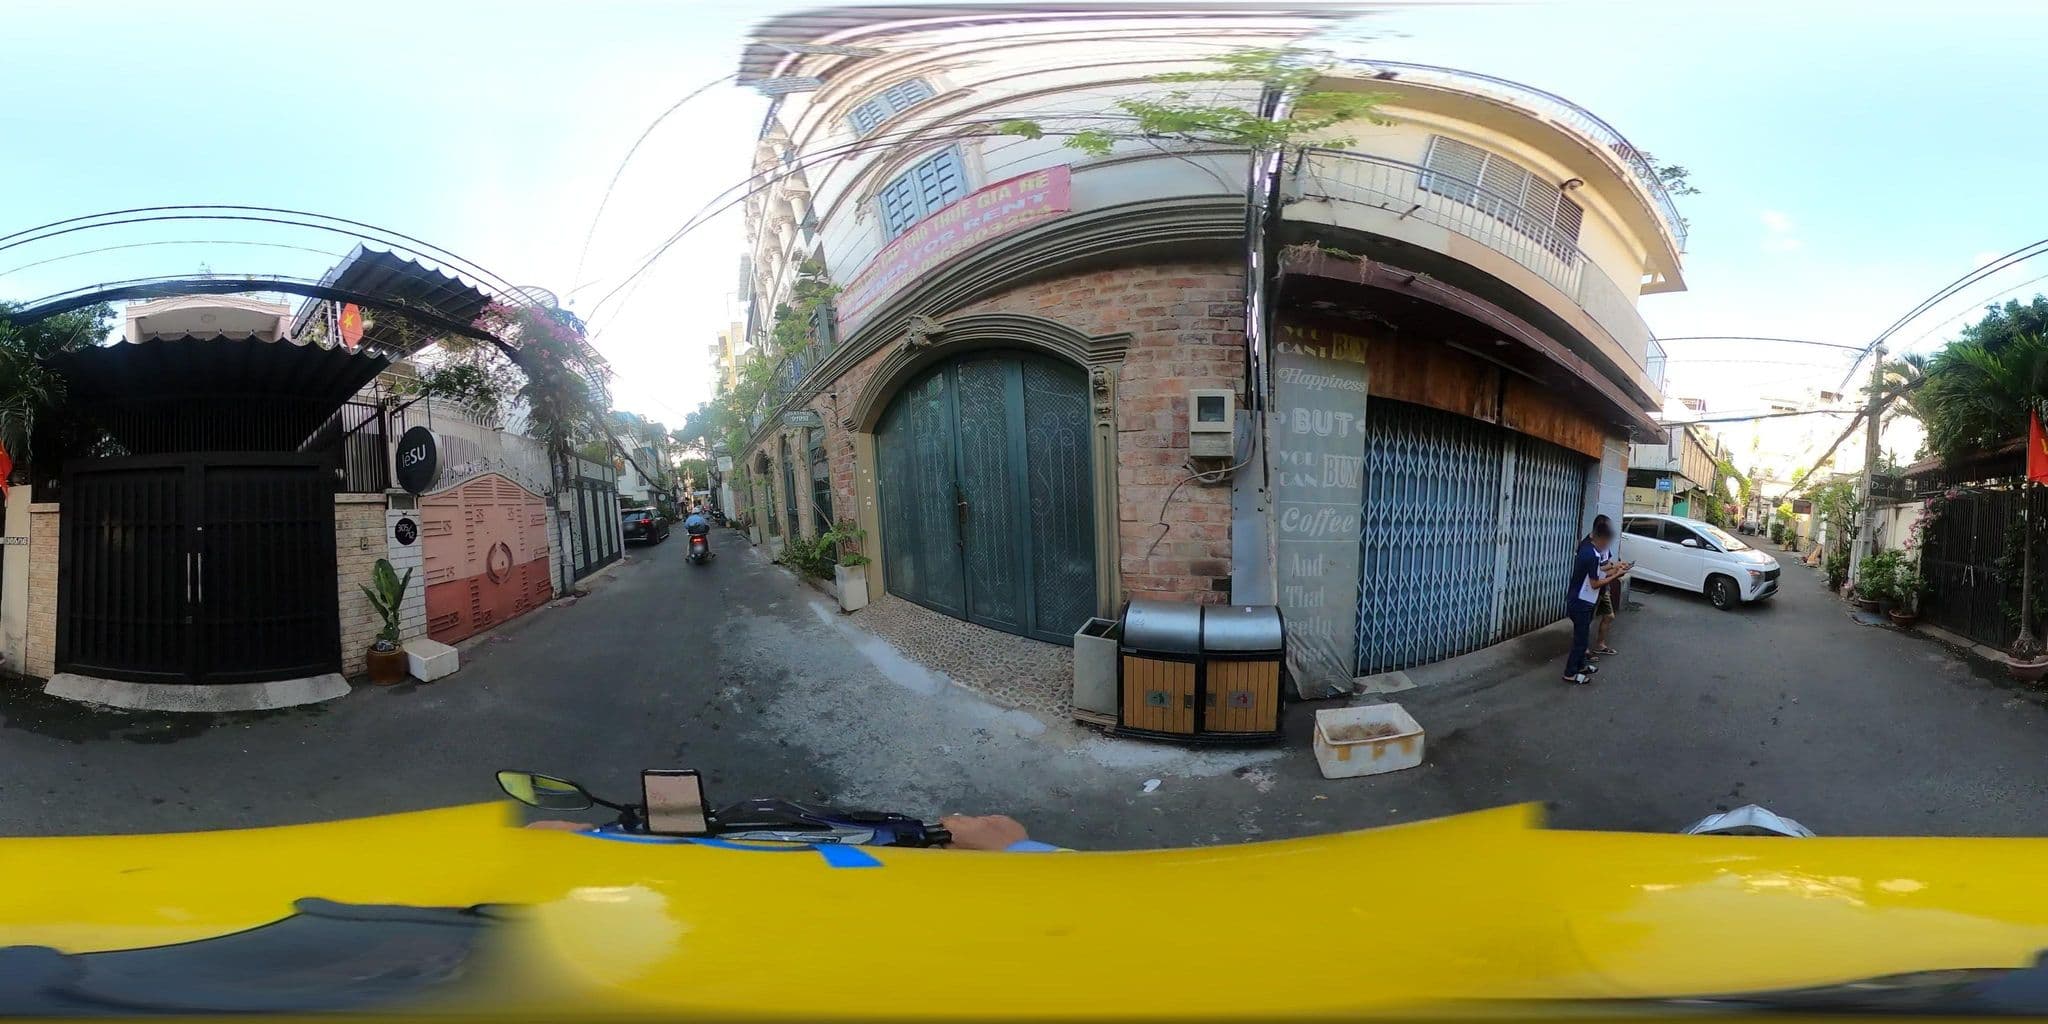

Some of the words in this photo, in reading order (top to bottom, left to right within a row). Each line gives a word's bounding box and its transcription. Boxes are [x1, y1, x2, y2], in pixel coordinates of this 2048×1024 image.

[962, 192, 1049, 230] RENT
[1278, 367, 1366, 393] Happiness
[1292, 408, 1354, 438] BUT
[1280, 472, 1318, 488] CAN
[1323, 454, 1362, 488] BUY
[1280, 505, 1354, 536] Coffee
[1291, 552, 1323, 578] And
[1286, 585, 1325, 608] That
